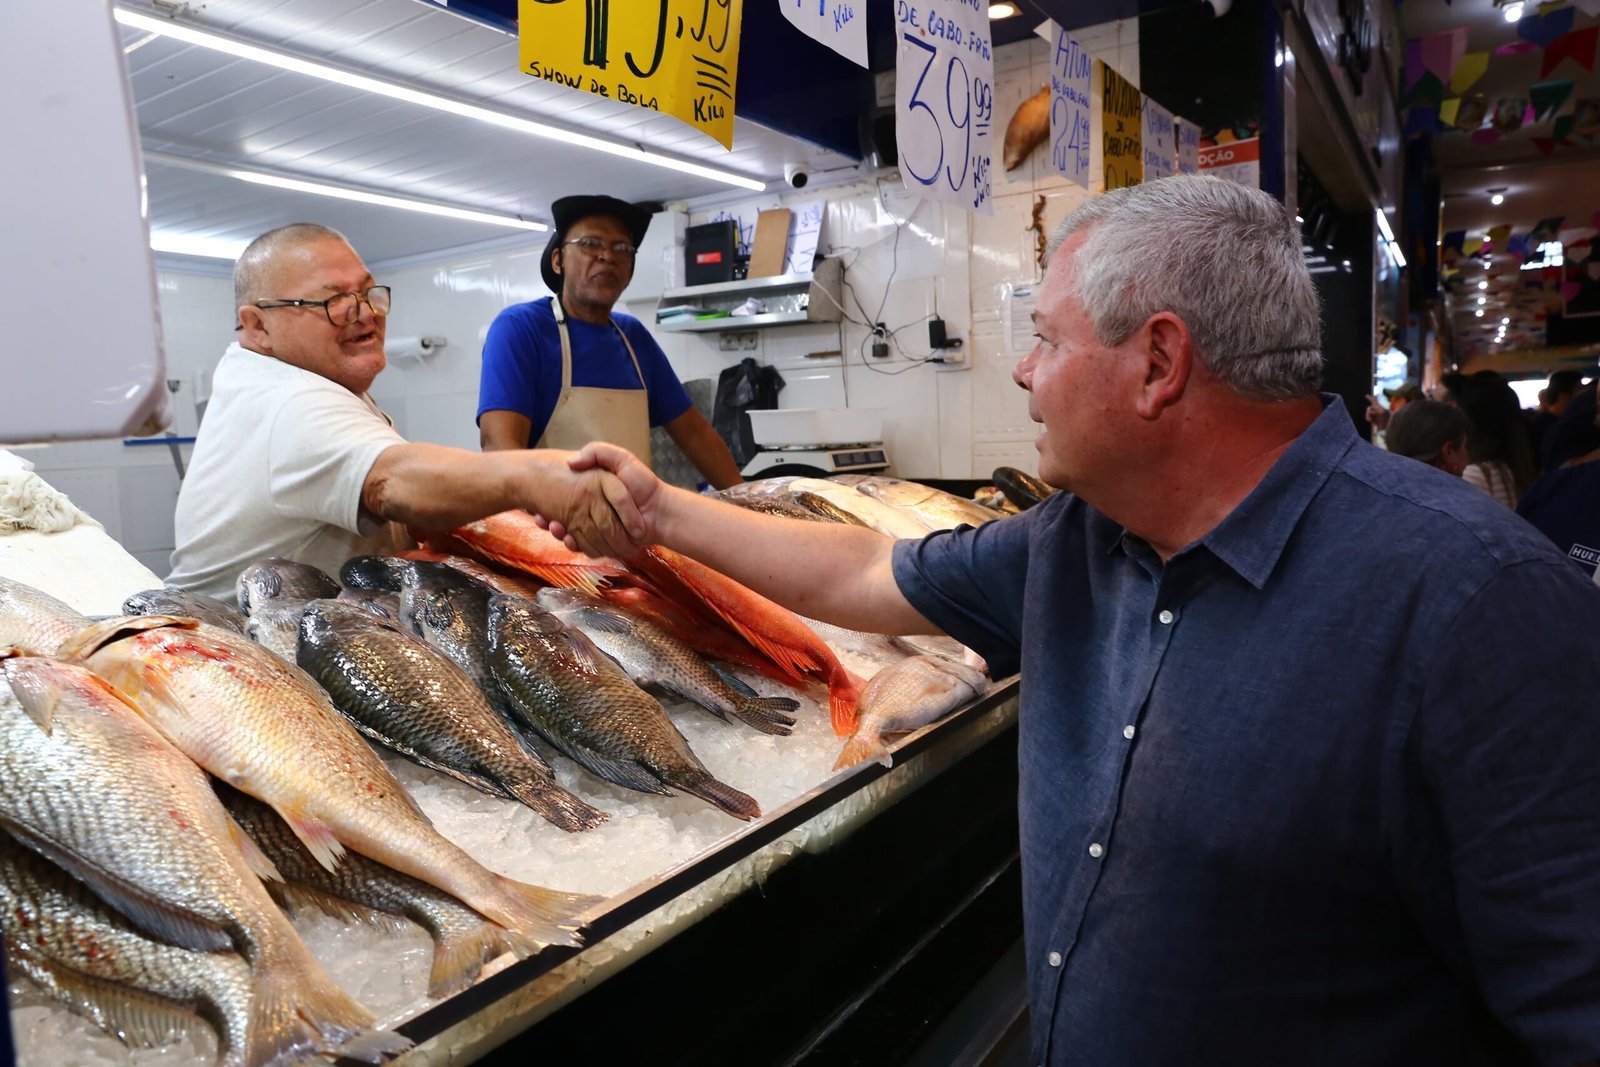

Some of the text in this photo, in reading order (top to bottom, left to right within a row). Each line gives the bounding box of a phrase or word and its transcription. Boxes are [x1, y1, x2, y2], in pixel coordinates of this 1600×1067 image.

[898, 1, 920, 27] DE
[525, 61, 582, 89] SHOW
[618, 84, 659, 111] BOLA
[1056, 28, 1091, 90] ATUM
[901, 32, 992, 192] 39 99
[1052, 96, 1080, 175] 24
